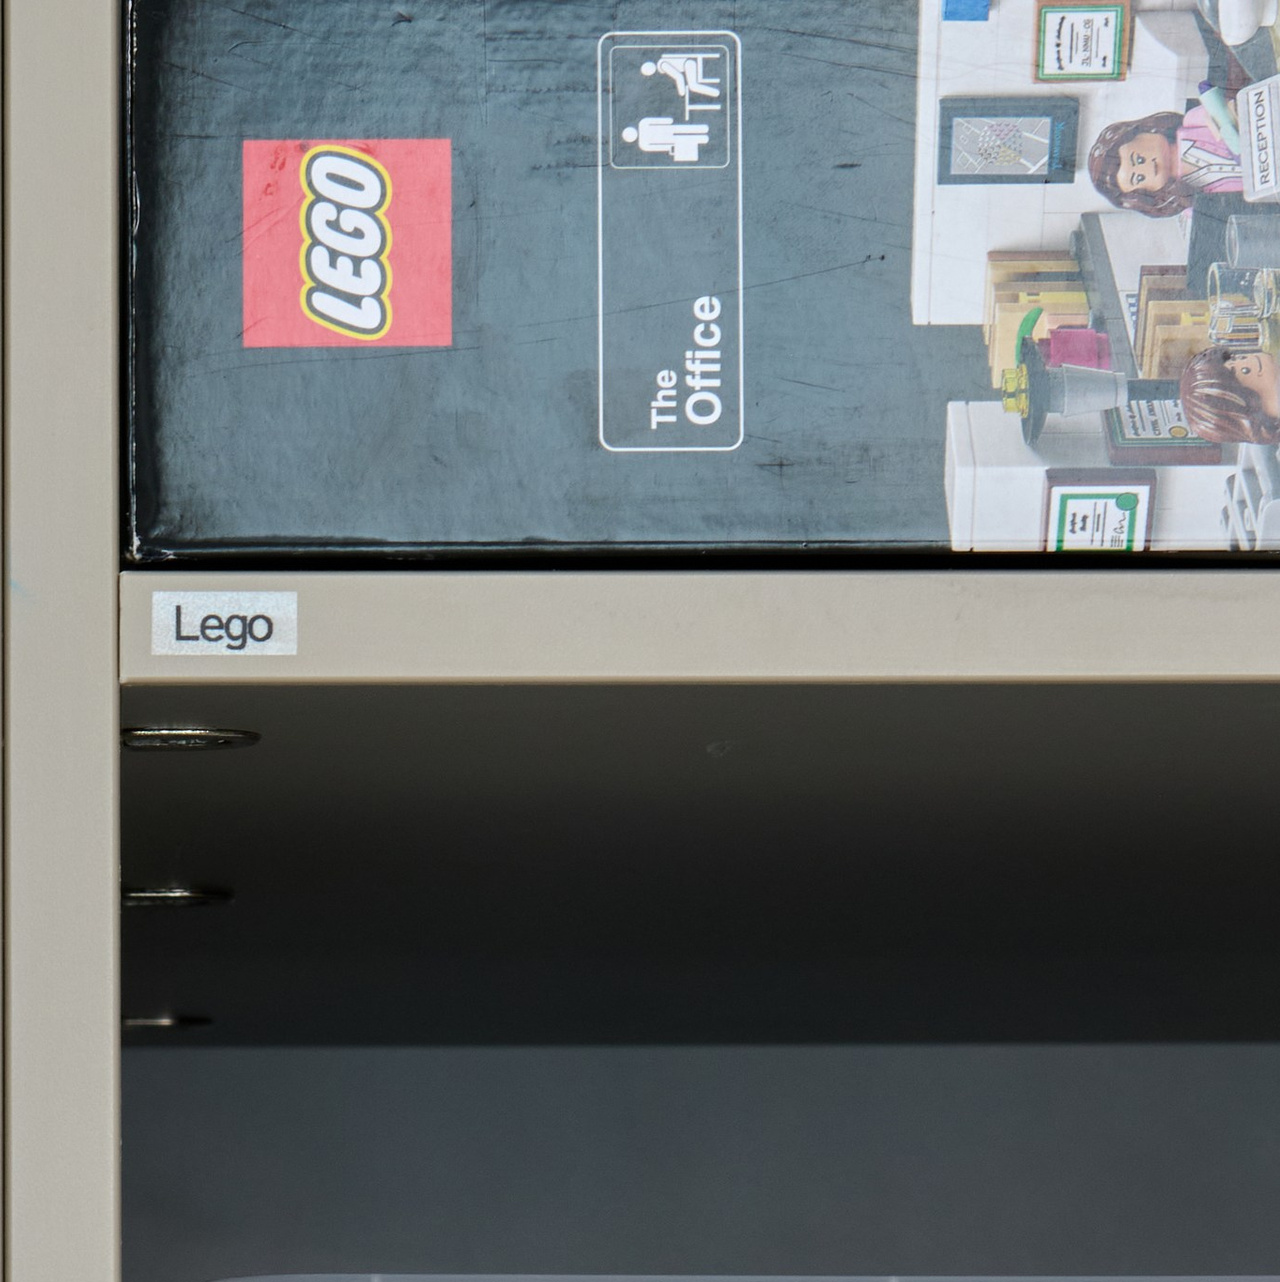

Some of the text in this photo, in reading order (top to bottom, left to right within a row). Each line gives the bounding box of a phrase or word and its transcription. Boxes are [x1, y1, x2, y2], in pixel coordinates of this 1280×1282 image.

[1254, 89, 1272, 186] RECEPTION
[306, 151, 387, 335] LEGO
[650, 369, 678, 430] The
[684, 295, 722, 425] Office
[175, 604, 274, 649] Lego
